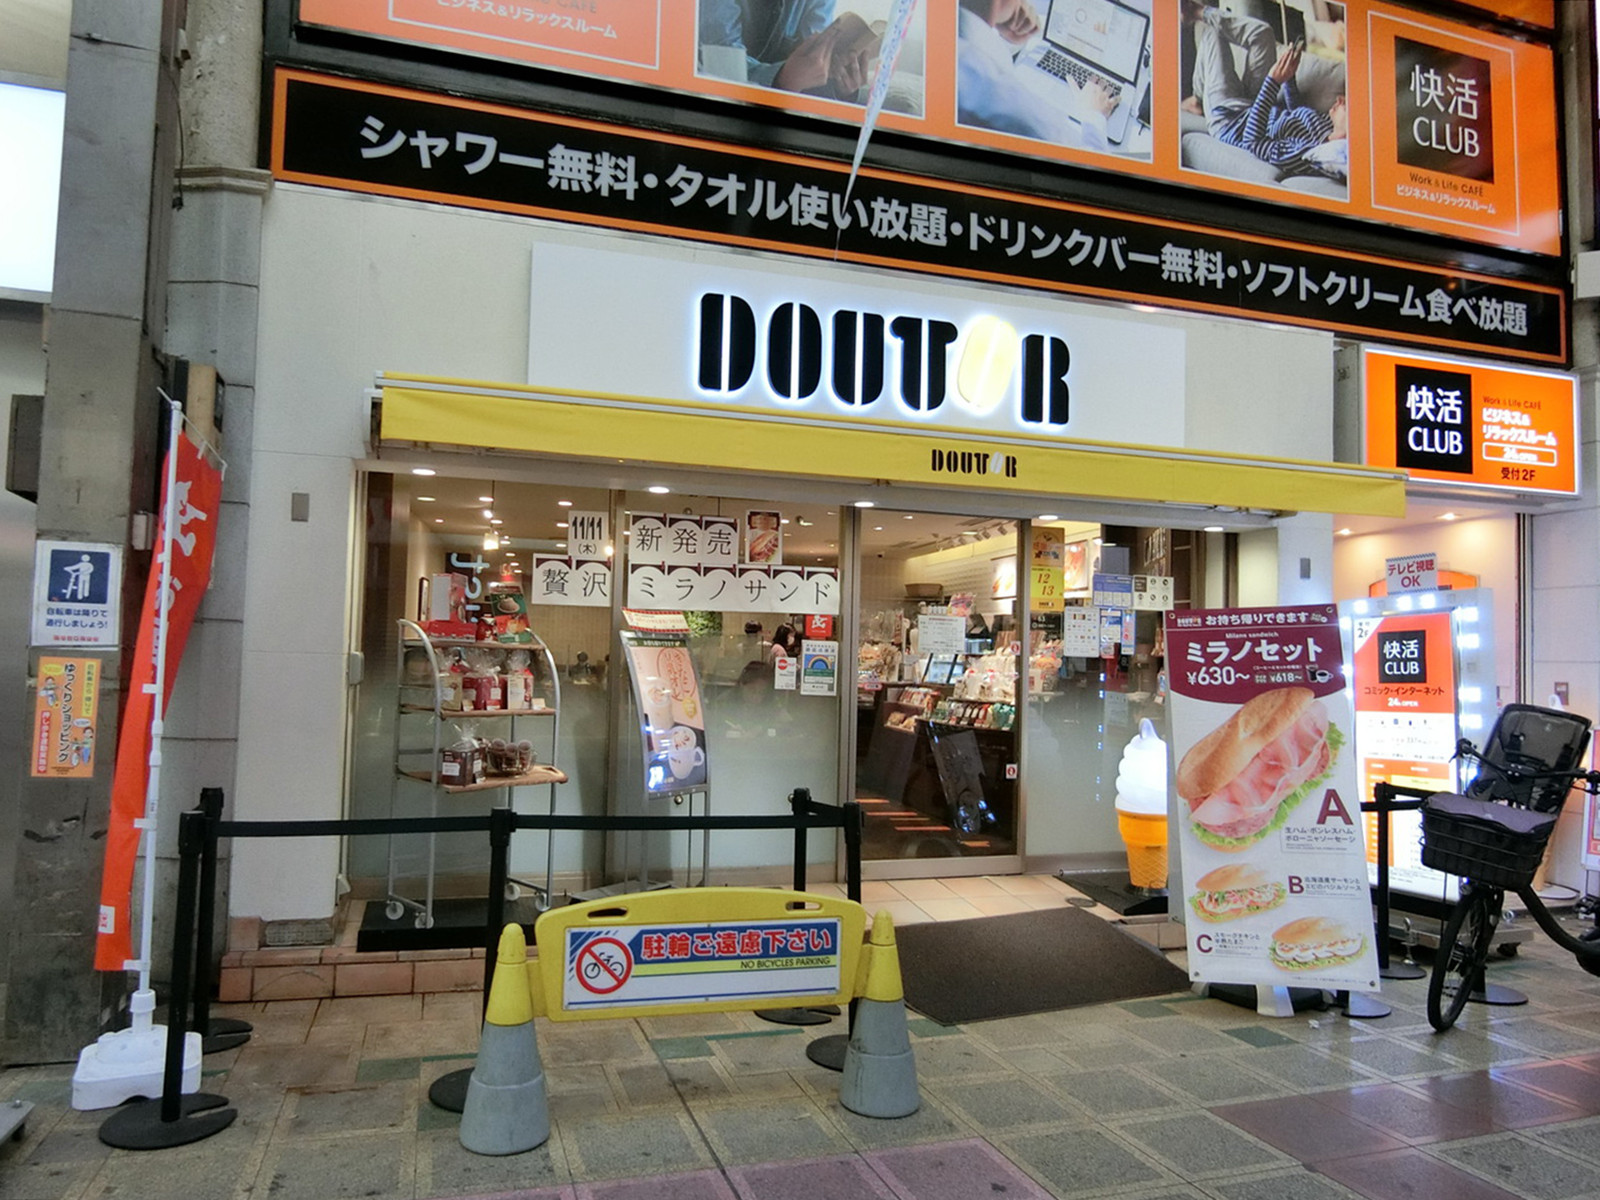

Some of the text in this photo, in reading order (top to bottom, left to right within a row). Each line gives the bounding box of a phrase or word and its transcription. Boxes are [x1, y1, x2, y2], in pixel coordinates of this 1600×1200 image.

[1410, 64, 1479, 120] 快活
[1412, 116, 1481, 158] CLUB
[1409, 172, 1432, 186] Work
[1442, 180, 1458, 191] Life
[698, 291, 1071, 428] DOUTOR
[1406, 384, 1463, 425] 快活
[1407, 426, 1463, 455] CLUB
[931, 449, 1017, 478] DOUTOR
[1501, 467, 1536, 481] 受付 2F
[572, 516, 602, 540] 11/11
[636, 524, 732, 556] 新発売
[577, 543, 598, 555] (木)
[1037, 573, 1051, 584] 12
[1388, 559, 1435, 576] テレビ視聴
[542, 569, 608, 598] 贅沢
[640, 575, 831, 605] ミラノサンド
[1401, 575, 1421, 588] OK
[1205, 612, 1309, 626] お持ち帰りできます
[1187, 637, 1323, 664] ミラノセット
[1383, 639, 1419, 659] 快活
[1384, 661, 1420, 675] CLUB
[1364, 685, 1445, 696] コミック・インターネット
[59, 663, 76, 763] ゆっくりショッピング
[1316, 788, 1354, 825] A
[1288, 875, 1304, 894] B
[641, 929, 831, 959] 駐輪ご遠慮下さい
[1196, 934, 1213, 953] C
[740, 956, 830, 969] NO BICYCLES PARKING
